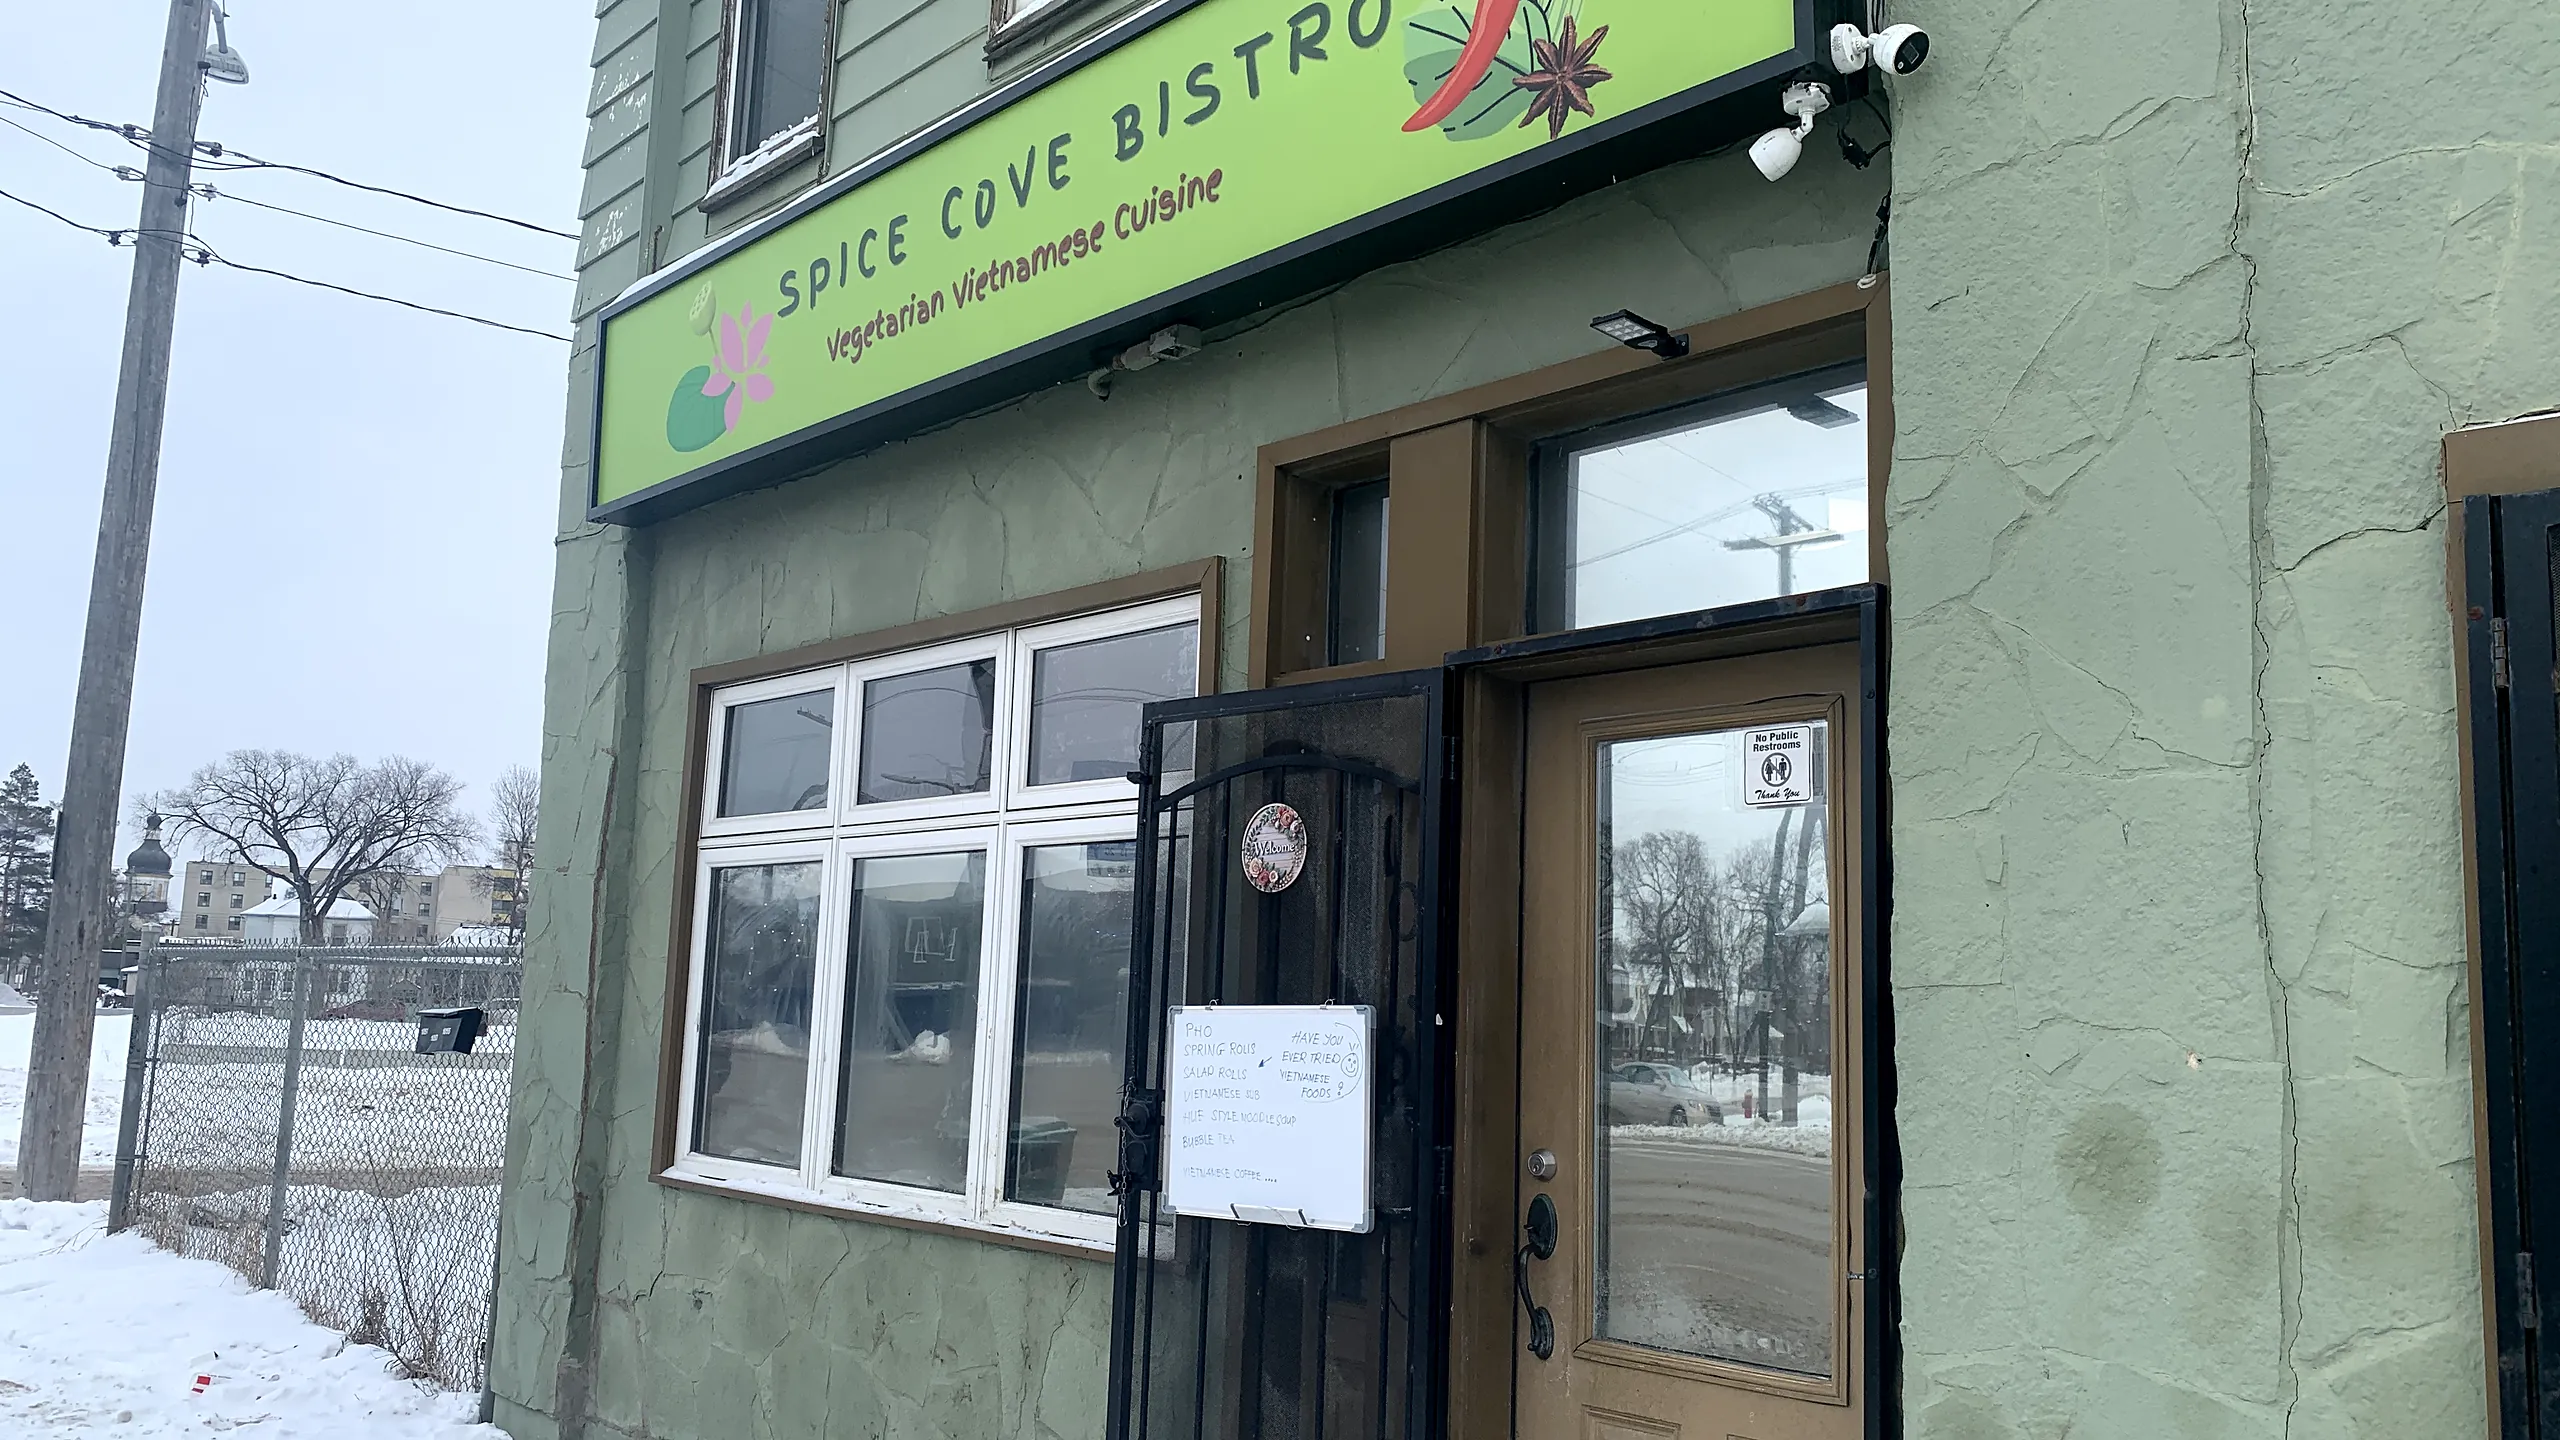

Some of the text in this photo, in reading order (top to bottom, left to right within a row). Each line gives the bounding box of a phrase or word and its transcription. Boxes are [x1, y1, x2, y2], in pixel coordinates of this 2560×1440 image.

[776, 0, 1391, 318] SPICE COVE BISTRO
[827, 168, 1223, 364] Vegetarian Vietnamese Cuisine
[1755, 731, 1799, 743] No Public
[1753, 741, 1801, 752] Restrooms
[1755, 787, 1800, 800] Thank You
[1253, 841, 1295, 856] Welcome
[1185, 1022, 1213, 1038] PHO
[1291, 1031, 1344, 1046] HAVE YOU
[1184, 1042, 1225, 1057] SPRING
[1281, 1050, 1341, 1064] EVER TRIED
[1184, 1065, 1247, 1080] SALAD ROLLS
[1280, 1069, 1330, 1084] VIETNAMESE
[1183, 1088, 1260, 1102] VIETNAMESE SUB
[1301, 1087, 1331, 1098] FOODS
[1211, 1109, 1239, 1122] STYLE
[1182, 1132, 1235, 1148] BUBBLE TEA
